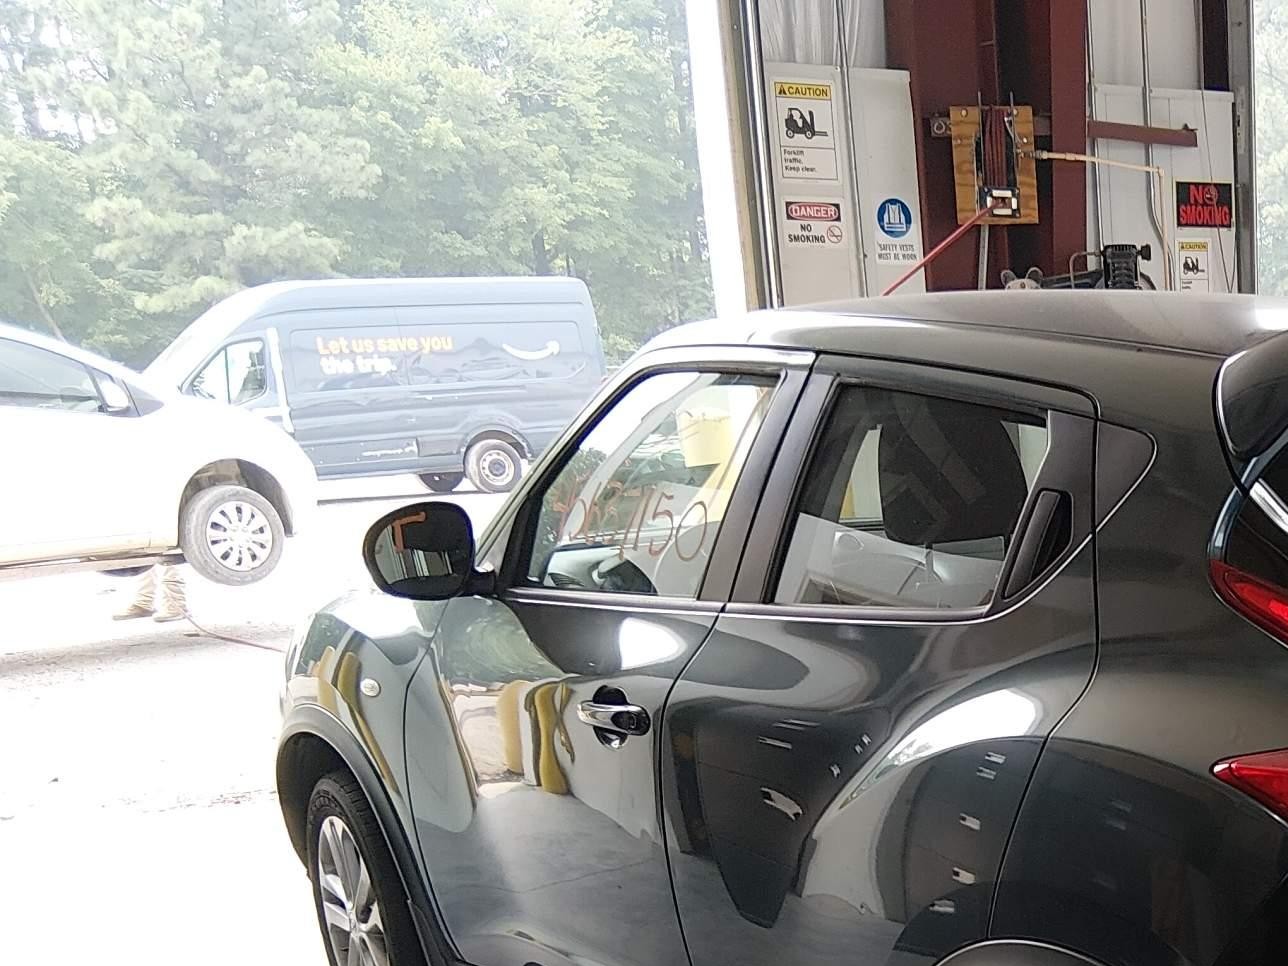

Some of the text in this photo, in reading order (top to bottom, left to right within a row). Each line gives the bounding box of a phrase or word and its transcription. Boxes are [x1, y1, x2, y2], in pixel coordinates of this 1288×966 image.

[787, 86, 828, 97] CAUTION
[1189, 184, 1218, 205] NO
[792, 205, 836, 218] DANGER
[1180, 205, 1230, 225] SMOKING
[800, 223, 812, 233] NO
[787, 234, 826, 244] SMOKING
[316, 335, 455, 355] Let us save you
[319, 353, 398, 376] the trip.
